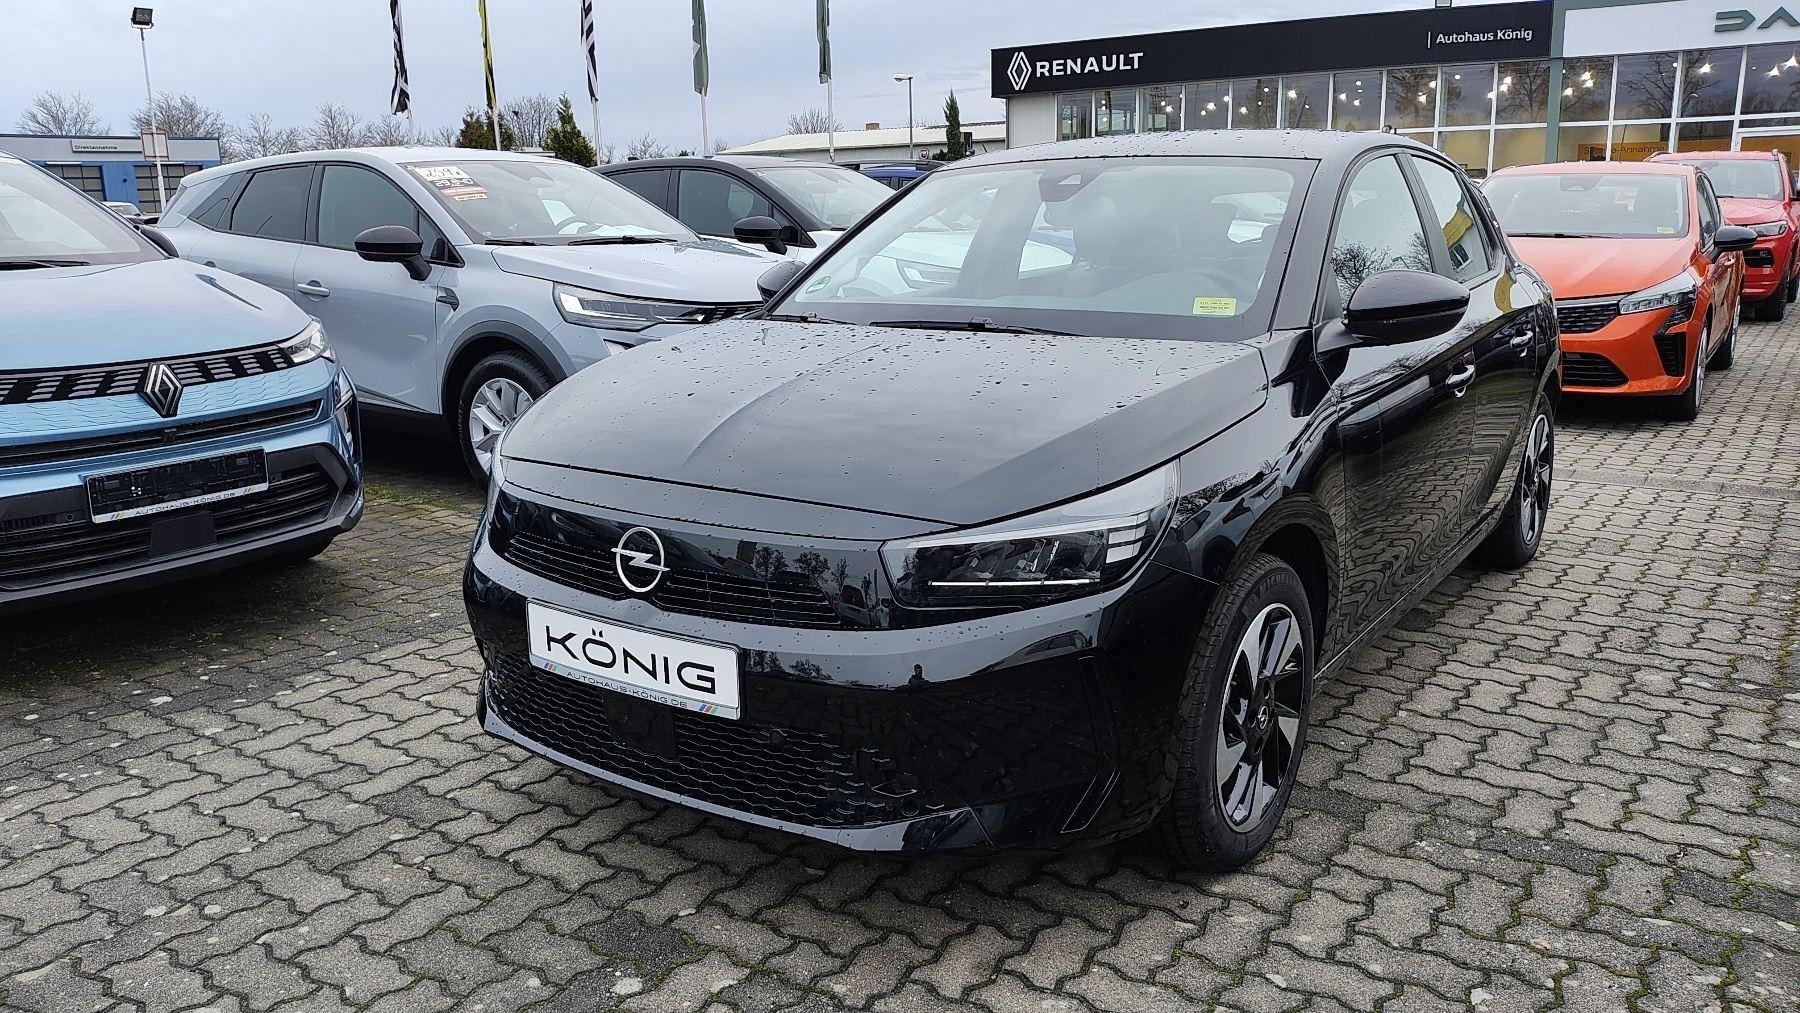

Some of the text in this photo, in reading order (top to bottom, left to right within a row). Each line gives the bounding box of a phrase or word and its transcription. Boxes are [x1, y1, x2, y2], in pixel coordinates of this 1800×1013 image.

[1435, 28, 1533, 44] Autohaus König
[1036, 52, 1144, 78] RENAULT
[1584, 145, 1665, 155] Se-Annahme
[545, 625, 716, 695] KÖNIG
[566, 671, 688, 709] AUTOHAUS-KÖNIG.DE
